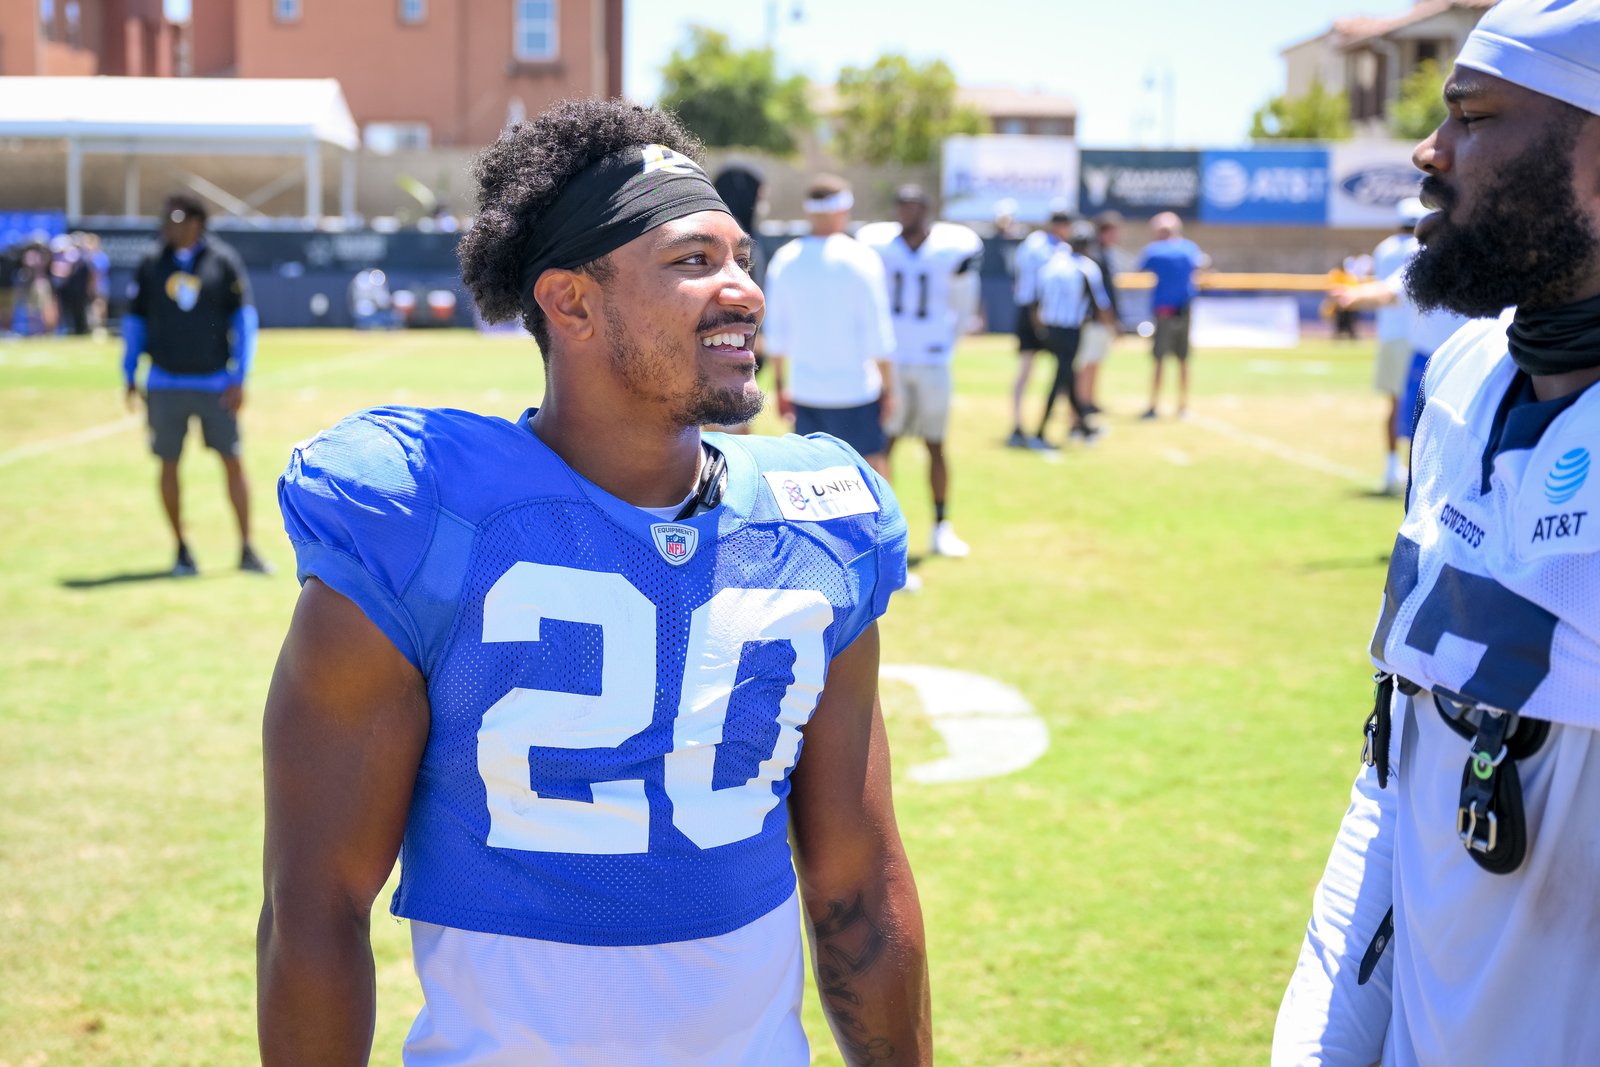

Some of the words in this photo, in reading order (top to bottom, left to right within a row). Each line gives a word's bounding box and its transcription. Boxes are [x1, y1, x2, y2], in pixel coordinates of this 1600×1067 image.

[892, 270, 929, 318] 11
[812, 479, 862, 497] UNIFY
[657, 527, 693, 536] EQUIPMENT
[1440, 504, 1485, 549] COWBOYS
[1532, 511, 1588, 544] AT&T
[668, 543, 685, 555] NFL
[477, 561, 834, 854] 20
